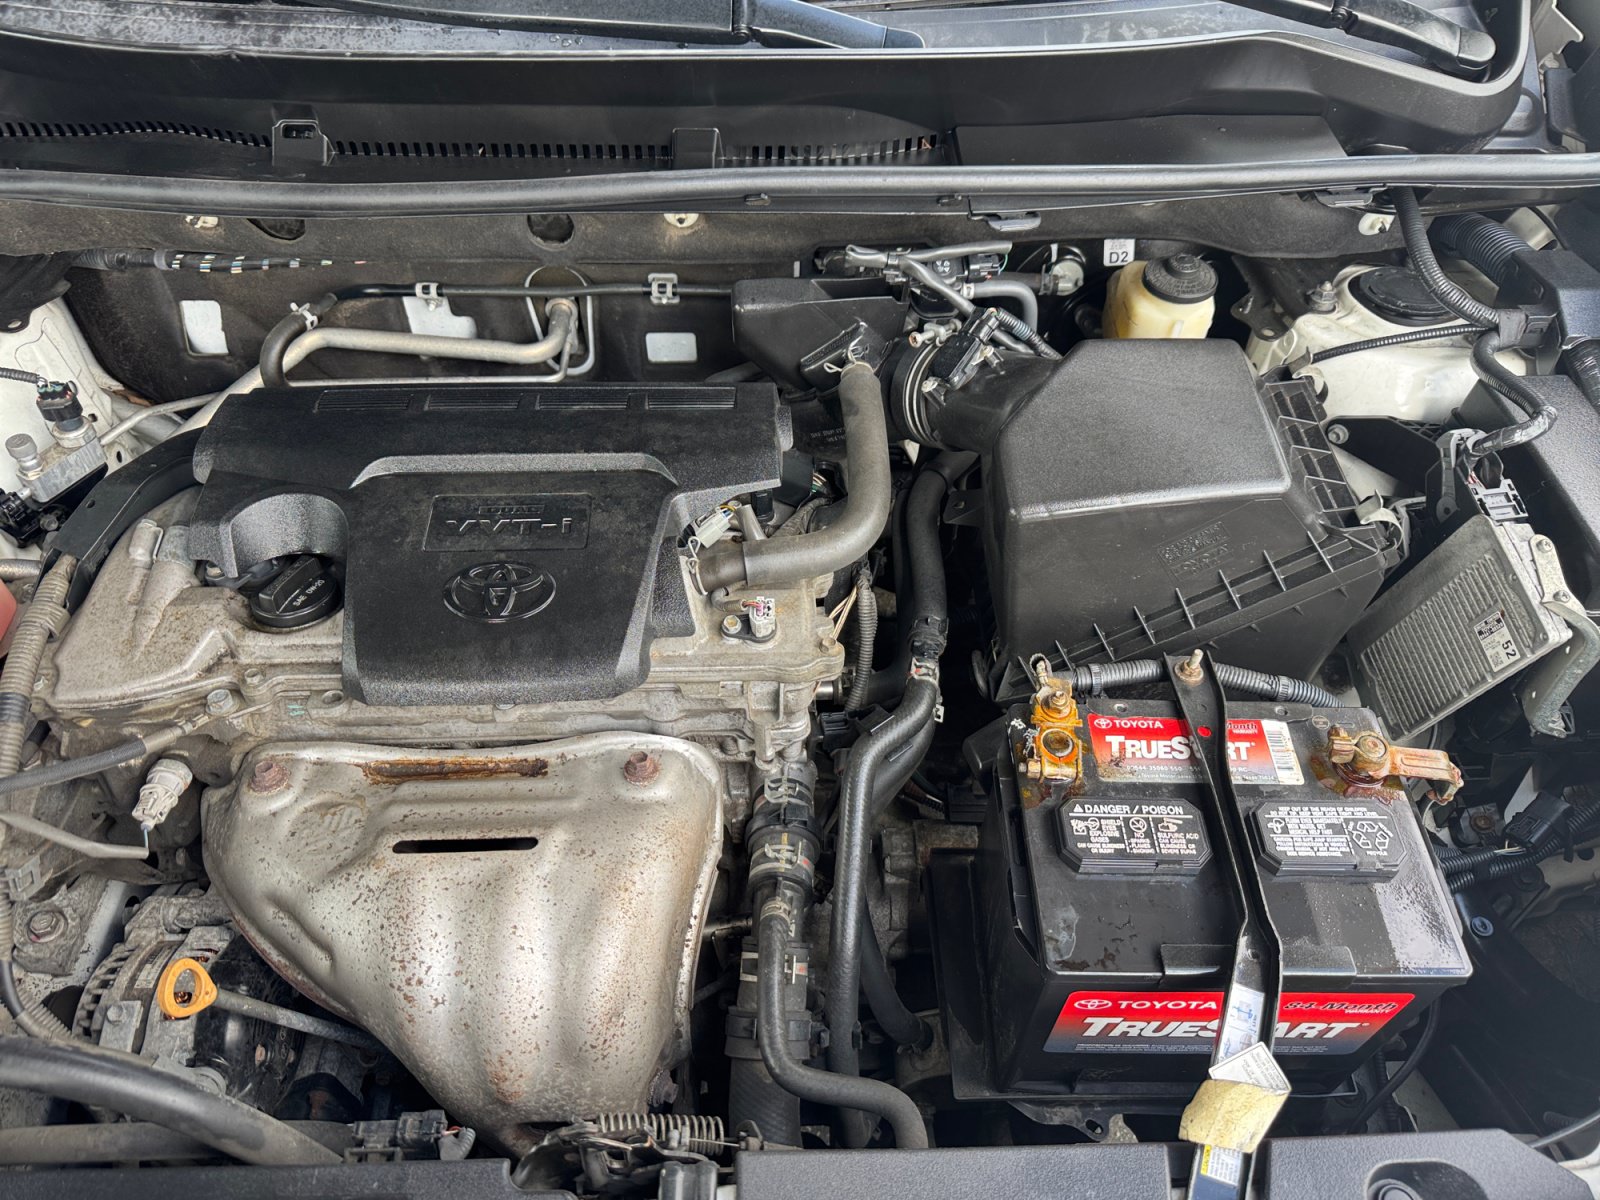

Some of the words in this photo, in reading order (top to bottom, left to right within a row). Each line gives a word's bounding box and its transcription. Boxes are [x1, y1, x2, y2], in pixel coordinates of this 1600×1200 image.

[1109, 251, 1129, 264] D2
[445, 517, 573, 535] VVT-i
[1501, 639, 1517, 660] 52
[1113, 719, 1164, 729] TOYOTA
[1084, 804, 1131, 814] DANGER
[1133, 804, 1139, 814] /
[1142, 805, 1184, 815] POISON
[1117, 1000, 1217, 1010] TOYOTA
